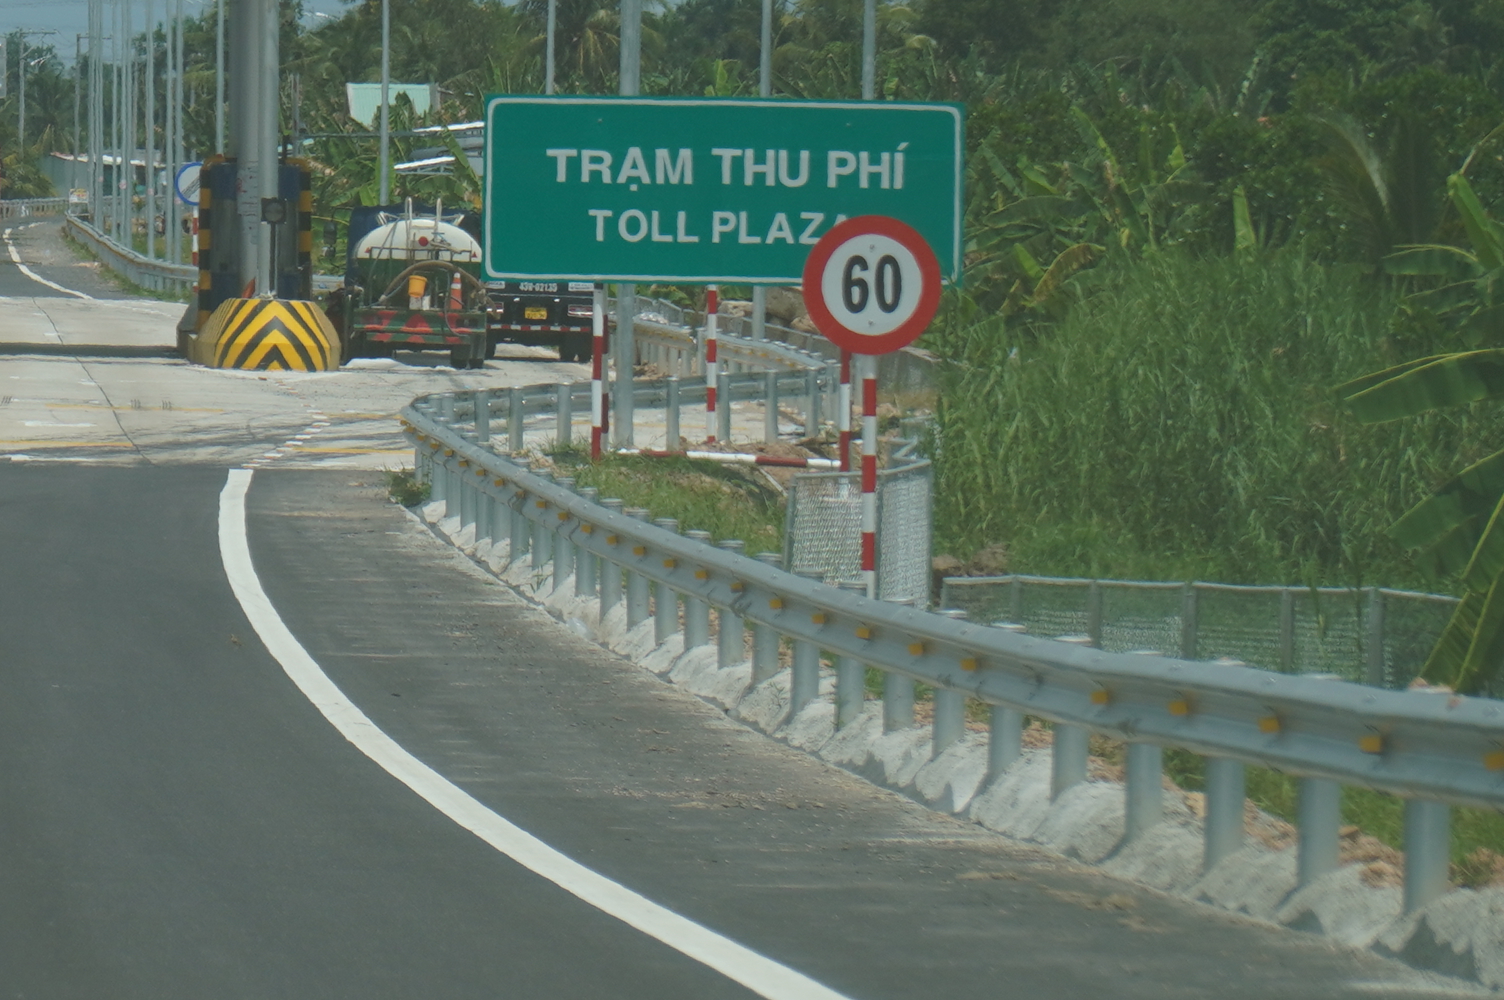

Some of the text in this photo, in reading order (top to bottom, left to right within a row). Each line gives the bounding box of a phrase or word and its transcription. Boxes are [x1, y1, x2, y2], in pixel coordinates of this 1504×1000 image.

[546, 142, 909, 191] TRẠM THU PHÍ
[588, 208, 848, 245] TOLL PLAZ
[842, 254, 902, 314] 60
